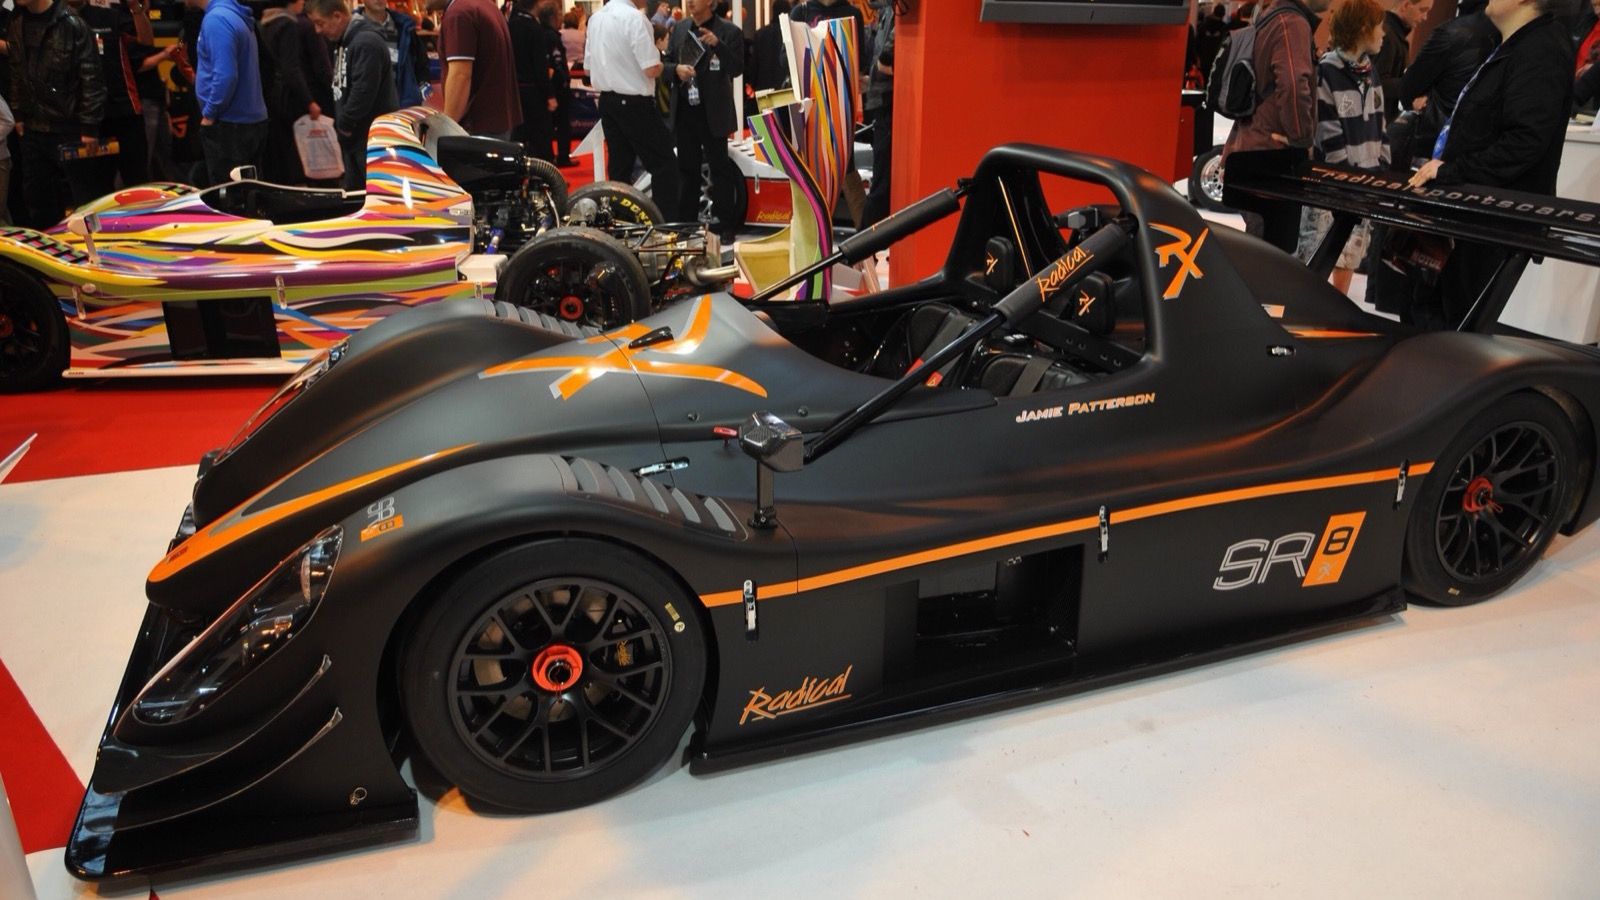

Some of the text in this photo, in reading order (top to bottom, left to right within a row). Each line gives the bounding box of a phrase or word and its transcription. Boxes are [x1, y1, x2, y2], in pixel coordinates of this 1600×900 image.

[1035, 245, 1094, 302] Radical
[1015, 392, 1156, 424] JAMIE PATTERSON
[739, 664, 853, 725] Radical
